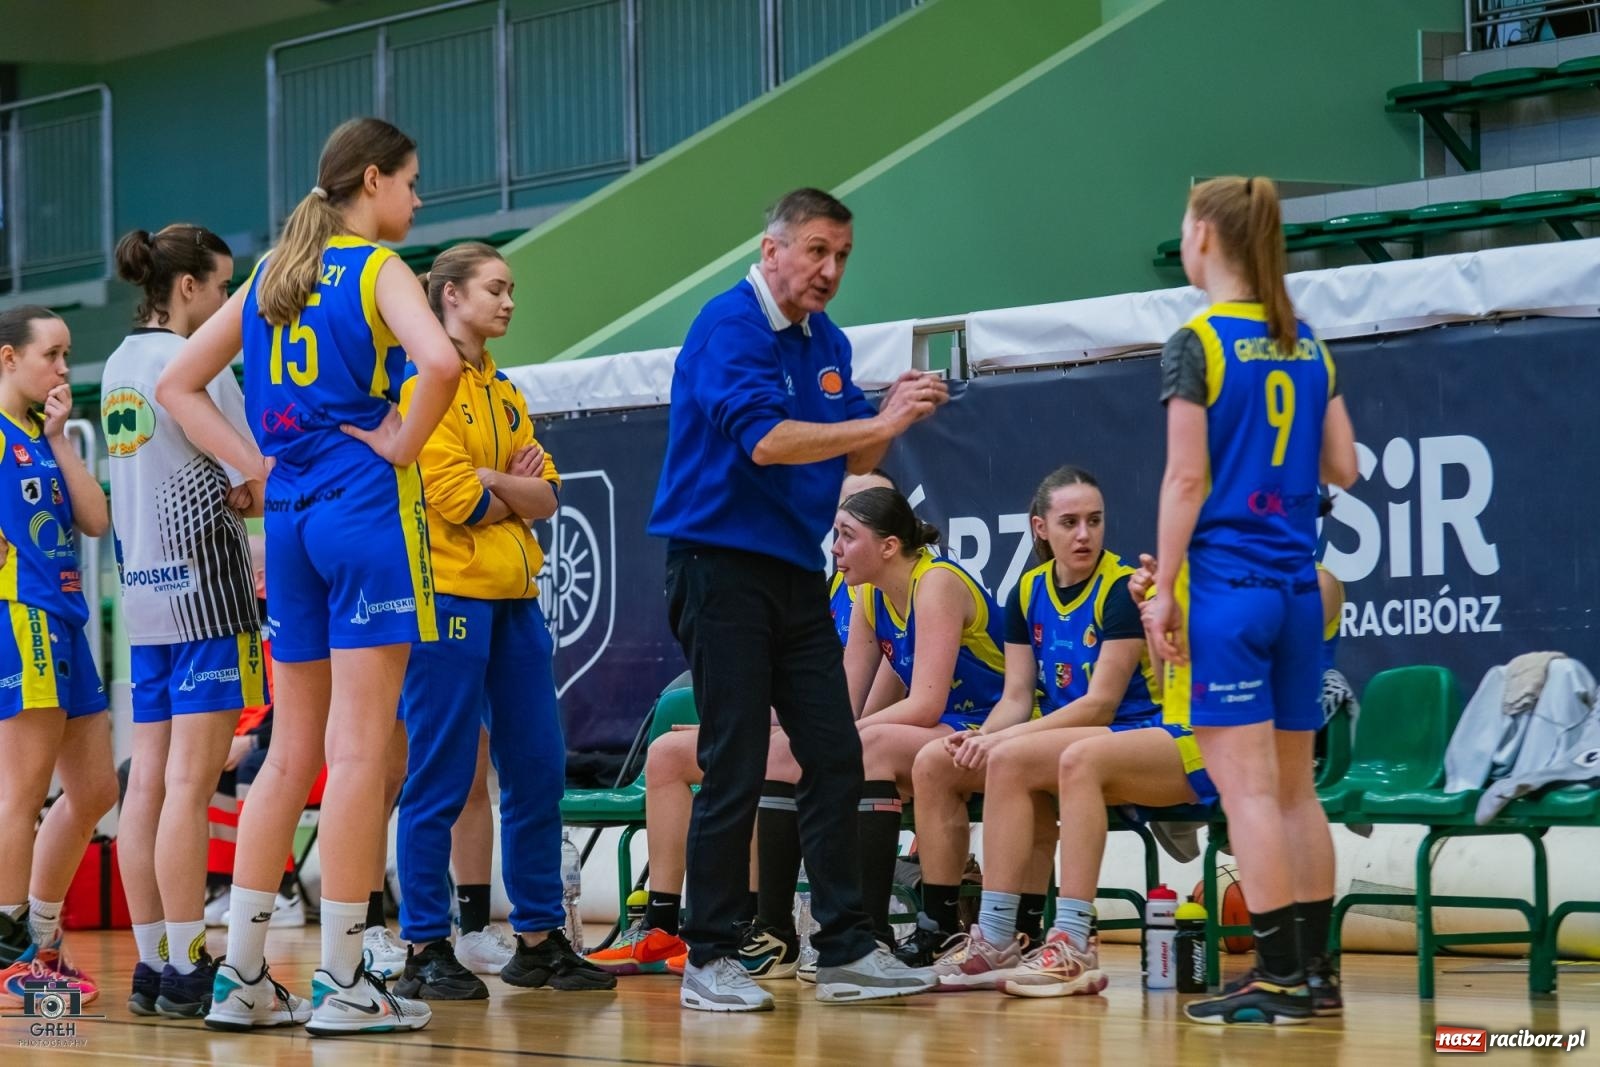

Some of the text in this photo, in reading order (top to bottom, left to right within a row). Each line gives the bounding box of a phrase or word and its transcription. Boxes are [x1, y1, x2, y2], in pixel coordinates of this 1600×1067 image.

[322, 264, 347, 287] ZY
[269, 293, 319, 387] 15
[461, 404, 473, 424] 5
[1265, 369, 1296, 466] 9
[1316, 434, 1500, 583] SiR
[126, 564, 190, 587] OPOLSKIE
[153, 580, 191, 593] KWITNĄCE
[1340, 584, 1502, 637] RACIBÓRZ
[449, 616, 467, 640] 15
[194, 668, 239, 682] OPOLSKIE
